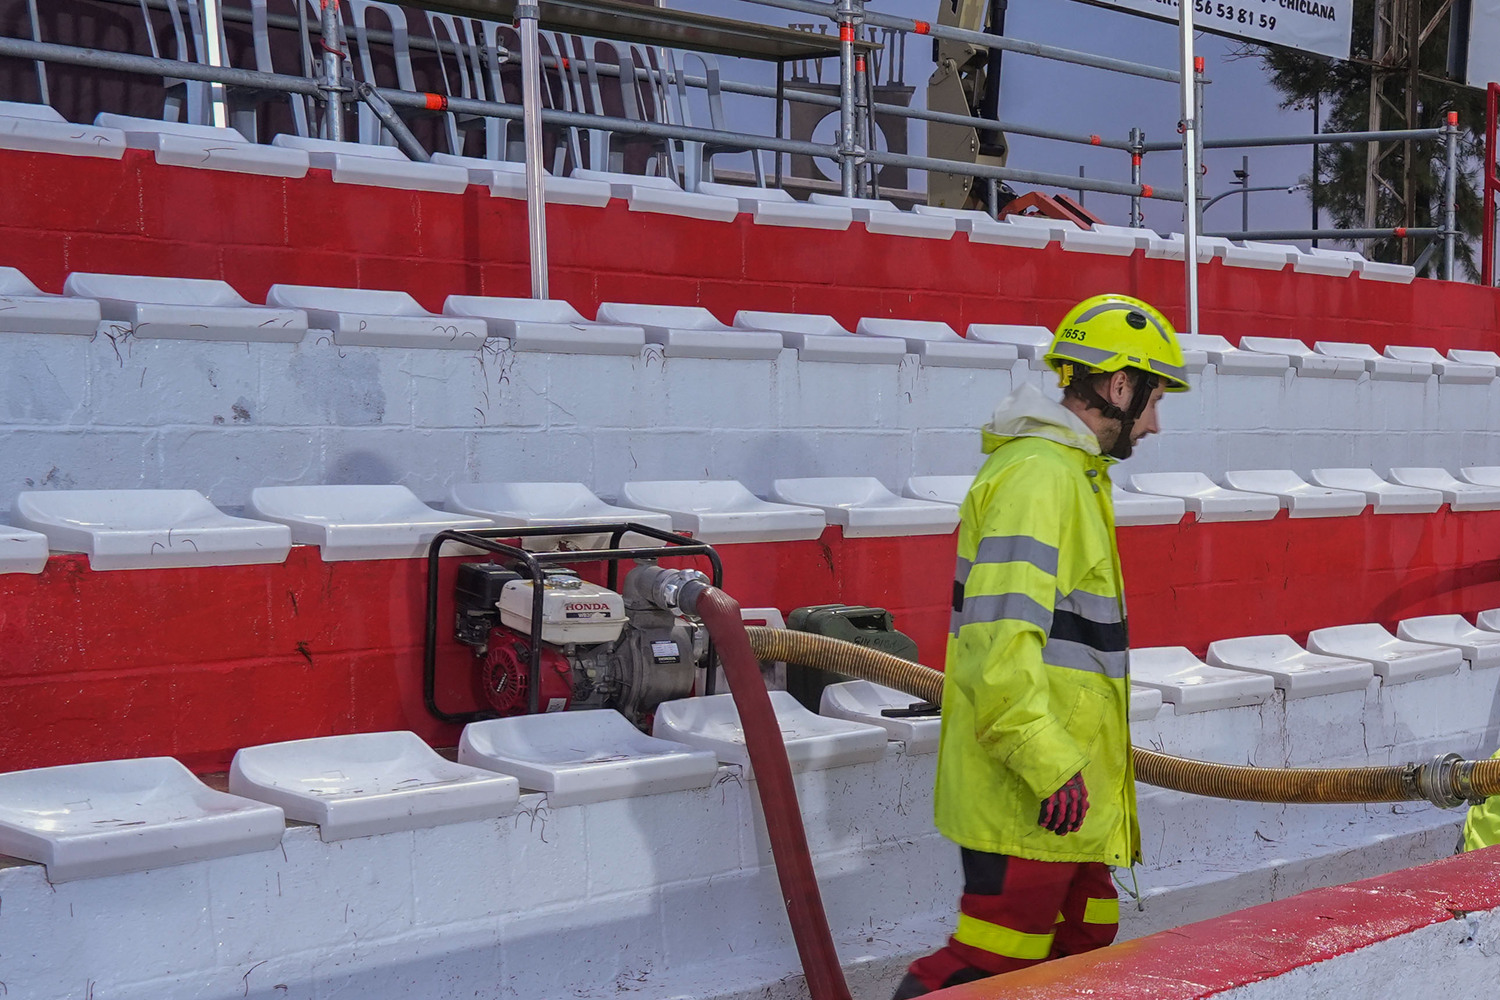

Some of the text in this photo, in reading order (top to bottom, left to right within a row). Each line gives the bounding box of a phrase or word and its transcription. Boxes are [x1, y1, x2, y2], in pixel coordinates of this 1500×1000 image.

[1216, 4, 1234, 20] 53
[1237, 8, 1254, 25] 81
[1259, 14, 1277, 31] 59
[565, 602, 610, 611] HONDA
